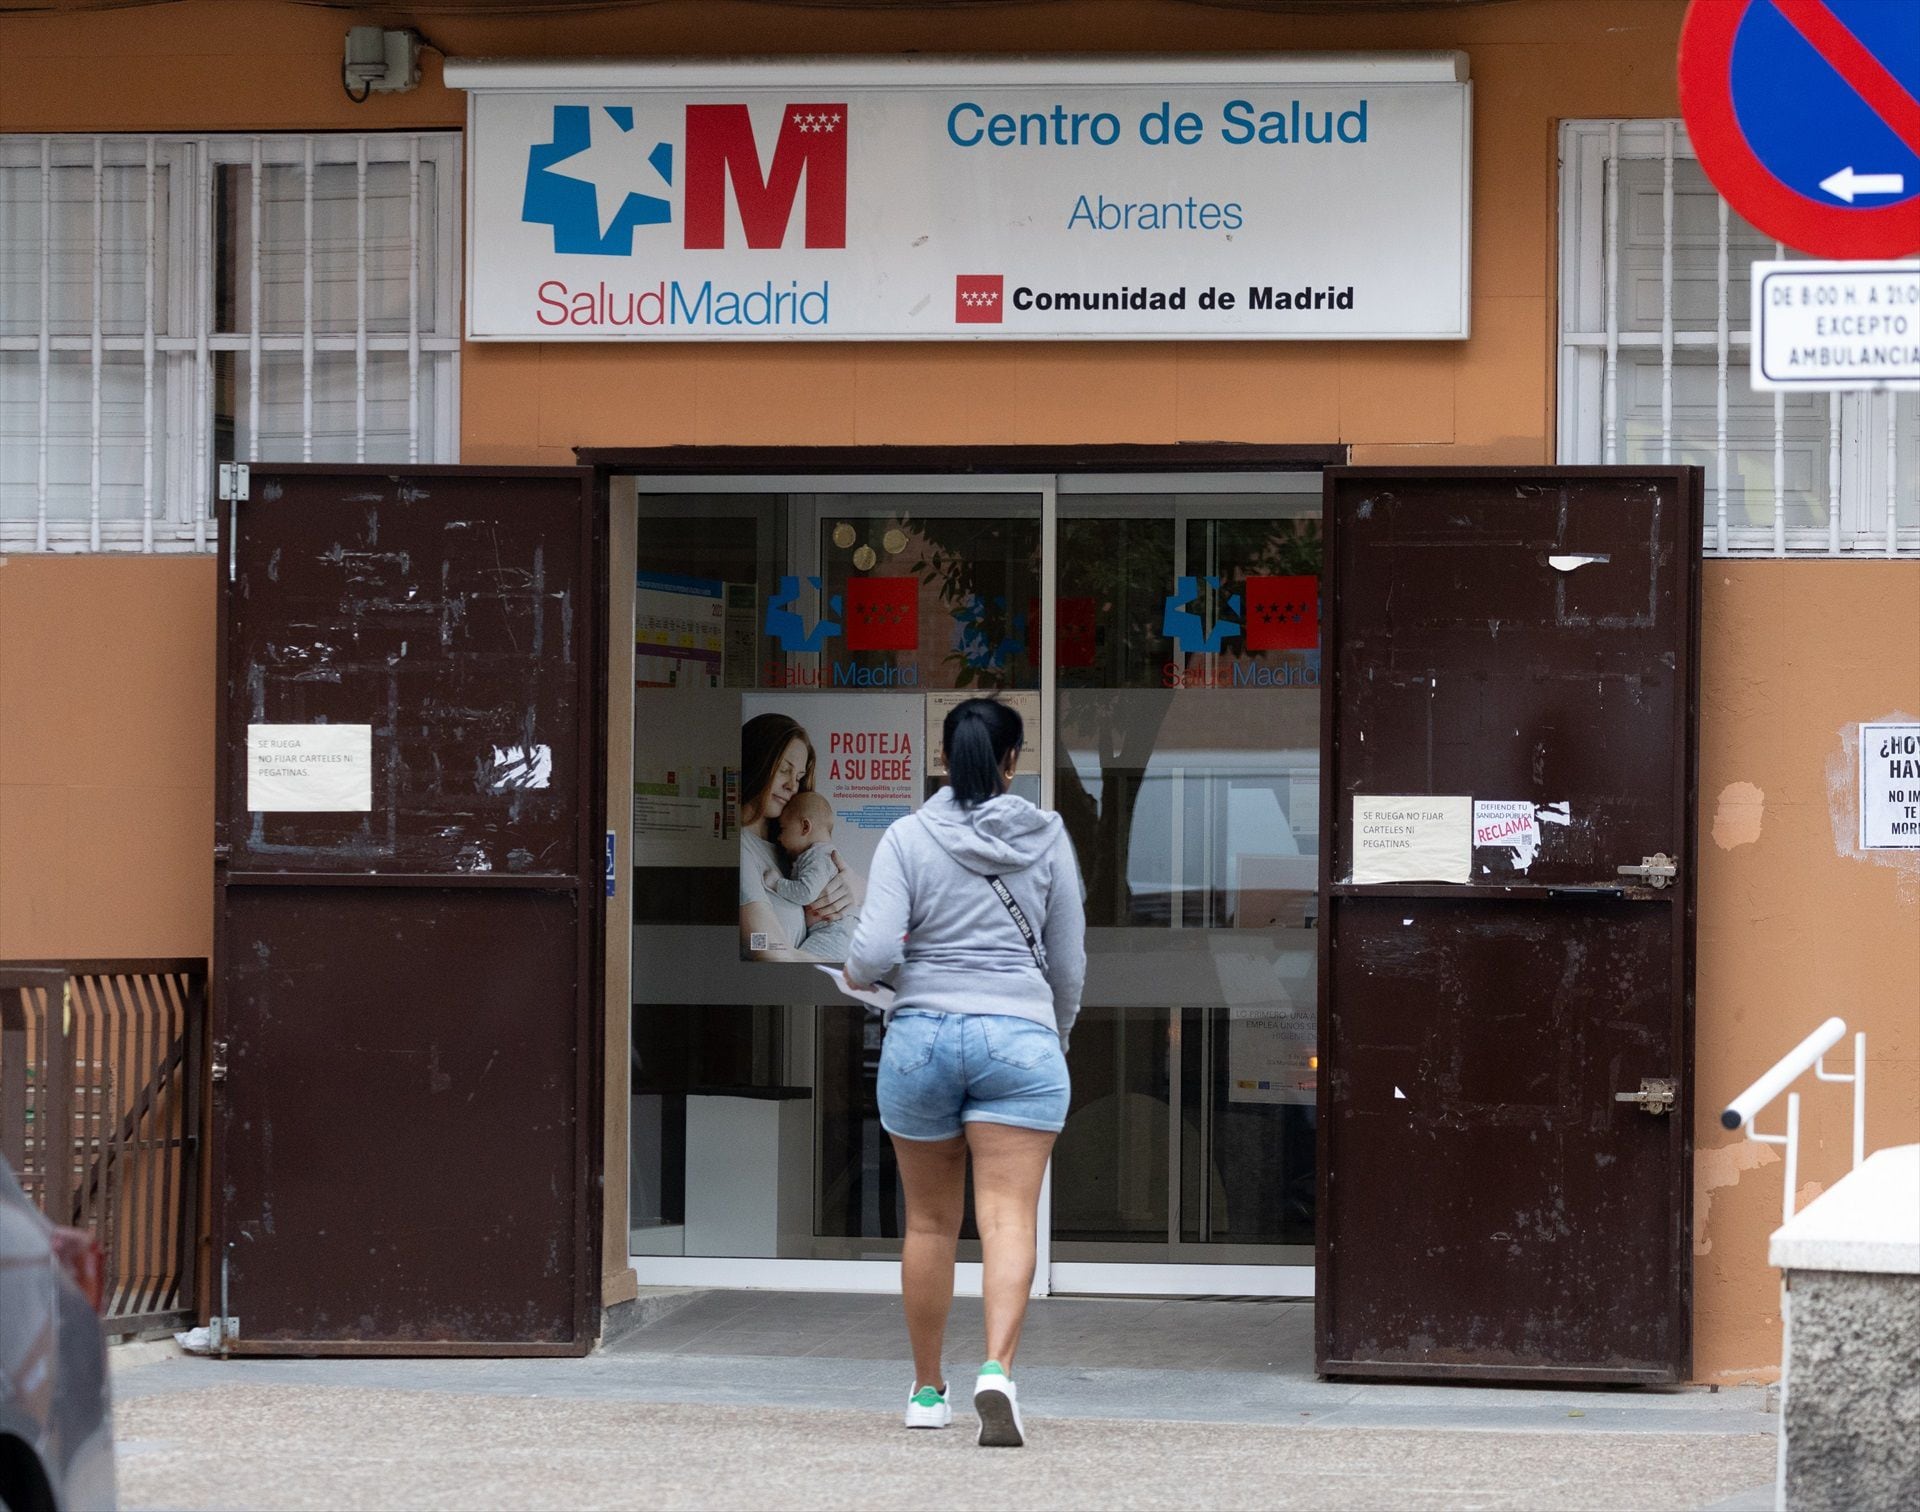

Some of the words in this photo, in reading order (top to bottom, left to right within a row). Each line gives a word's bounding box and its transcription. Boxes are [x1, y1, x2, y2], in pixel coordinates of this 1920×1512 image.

[946, 102, 1121, 147] Centro
[1139, 101, 1204, 146] de
[1220, 98, 1368, 144] Salud
[1067, 194, 1243, 230] Abrantes
[536, 280, 829, 326] SaludMadrid
[1012, 286, 1187, 311] Comunidad
[1198, 286, 1236, 310] de
[1248, 285, 1355, 310] Madrid
[1773, 286, 1791, 305] DE
[1868, 285, 1878, 304] A
[1817, 316, 1908, 335] EXCEPTO
[258, 740, 268, 748] SE
[270, 740, 301, 748] RUEGA
[830, 732, 912, 754] PROTEJA
[258, 754, 272, 763] NO
[274, 755, 297, 763] FIJAR
[299, 754, 342, 763] CARTELES
[344, 754, 353, 763] NI
[829, 759, 840, 780] A
[845, 759, 866, 780] SU
[870, 755, 912, 780] BEBÉ
[258, 768, 310, 777] PEGATINAS.
[1888, 790, 1904, 803] NO
[1363, 812, 1373, 820] SE
[1375, 812, 1404, 820] RUEGA
[1406, 812, 1420, 820] NO
[1422, 812, 1444, 820] FIJAR
[1904, 806, 1917, 819] TE
[1363, 826, 1403, 834] CARTELES
[1405, 826, 1415, 834] NI
[1477, 816, 1532, 843] RECLAMA
[991, 879, 1013, 906] YOUNG
[1009, 904, 1032, 938] FOREVER
[1246, 1021, 1279, 1030] EMPLEA
[1280, 1022, 1305, 1031] UNOS
